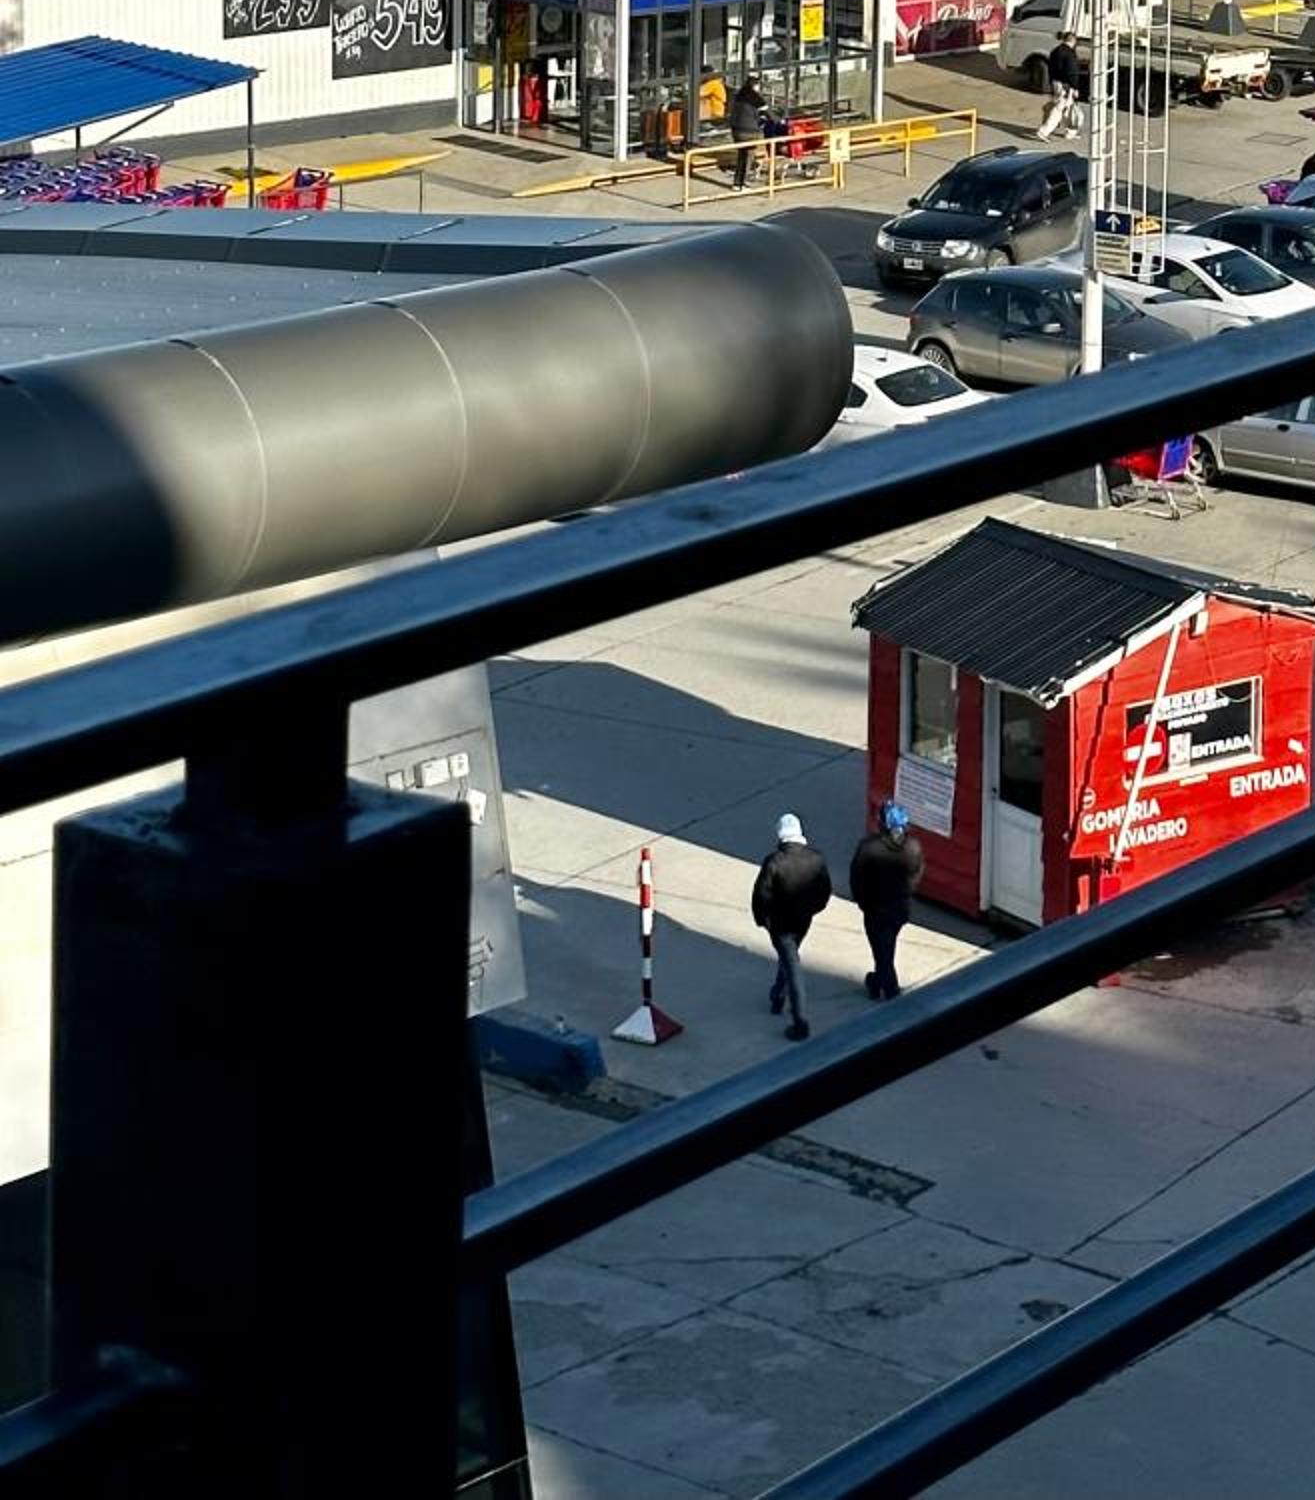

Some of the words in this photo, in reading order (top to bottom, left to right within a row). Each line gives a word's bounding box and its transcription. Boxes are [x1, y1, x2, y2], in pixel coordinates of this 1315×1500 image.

[1191, 734, 1252, 760] ENTRADA
[1230, 765, 1306, 797] ENTRADA
[1082, 798, 1161, 834] GOMRIA
